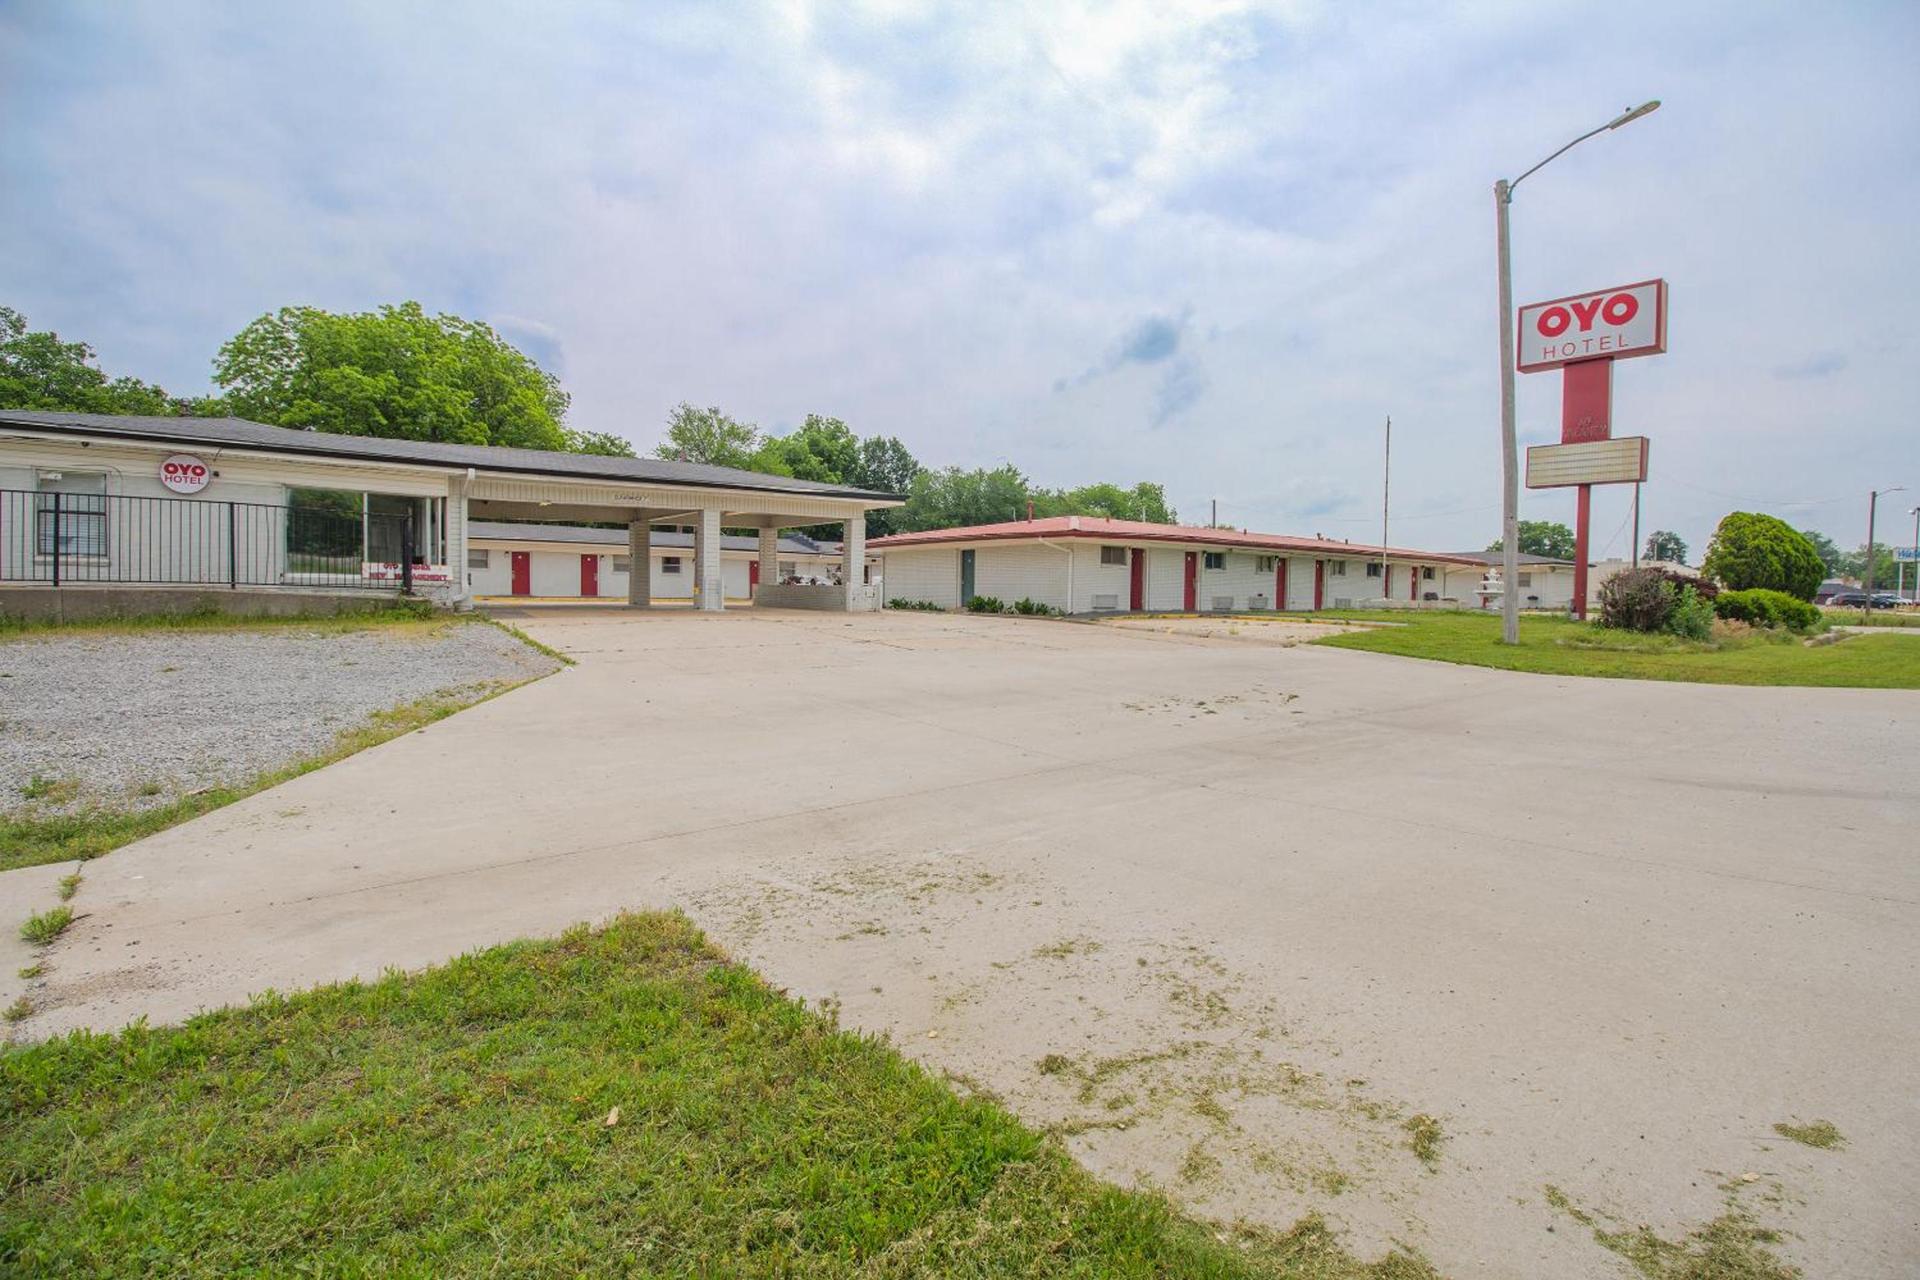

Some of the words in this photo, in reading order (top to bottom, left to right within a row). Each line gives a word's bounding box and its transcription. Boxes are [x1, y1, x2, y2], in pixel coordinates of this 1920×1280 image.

[1537, 293, 1639, 337] OYO
[1543, 334, 1629, 359] HOTEL
[163, 463, 206, 476] OYO
[164, 474, 204, 485] HOTEL
